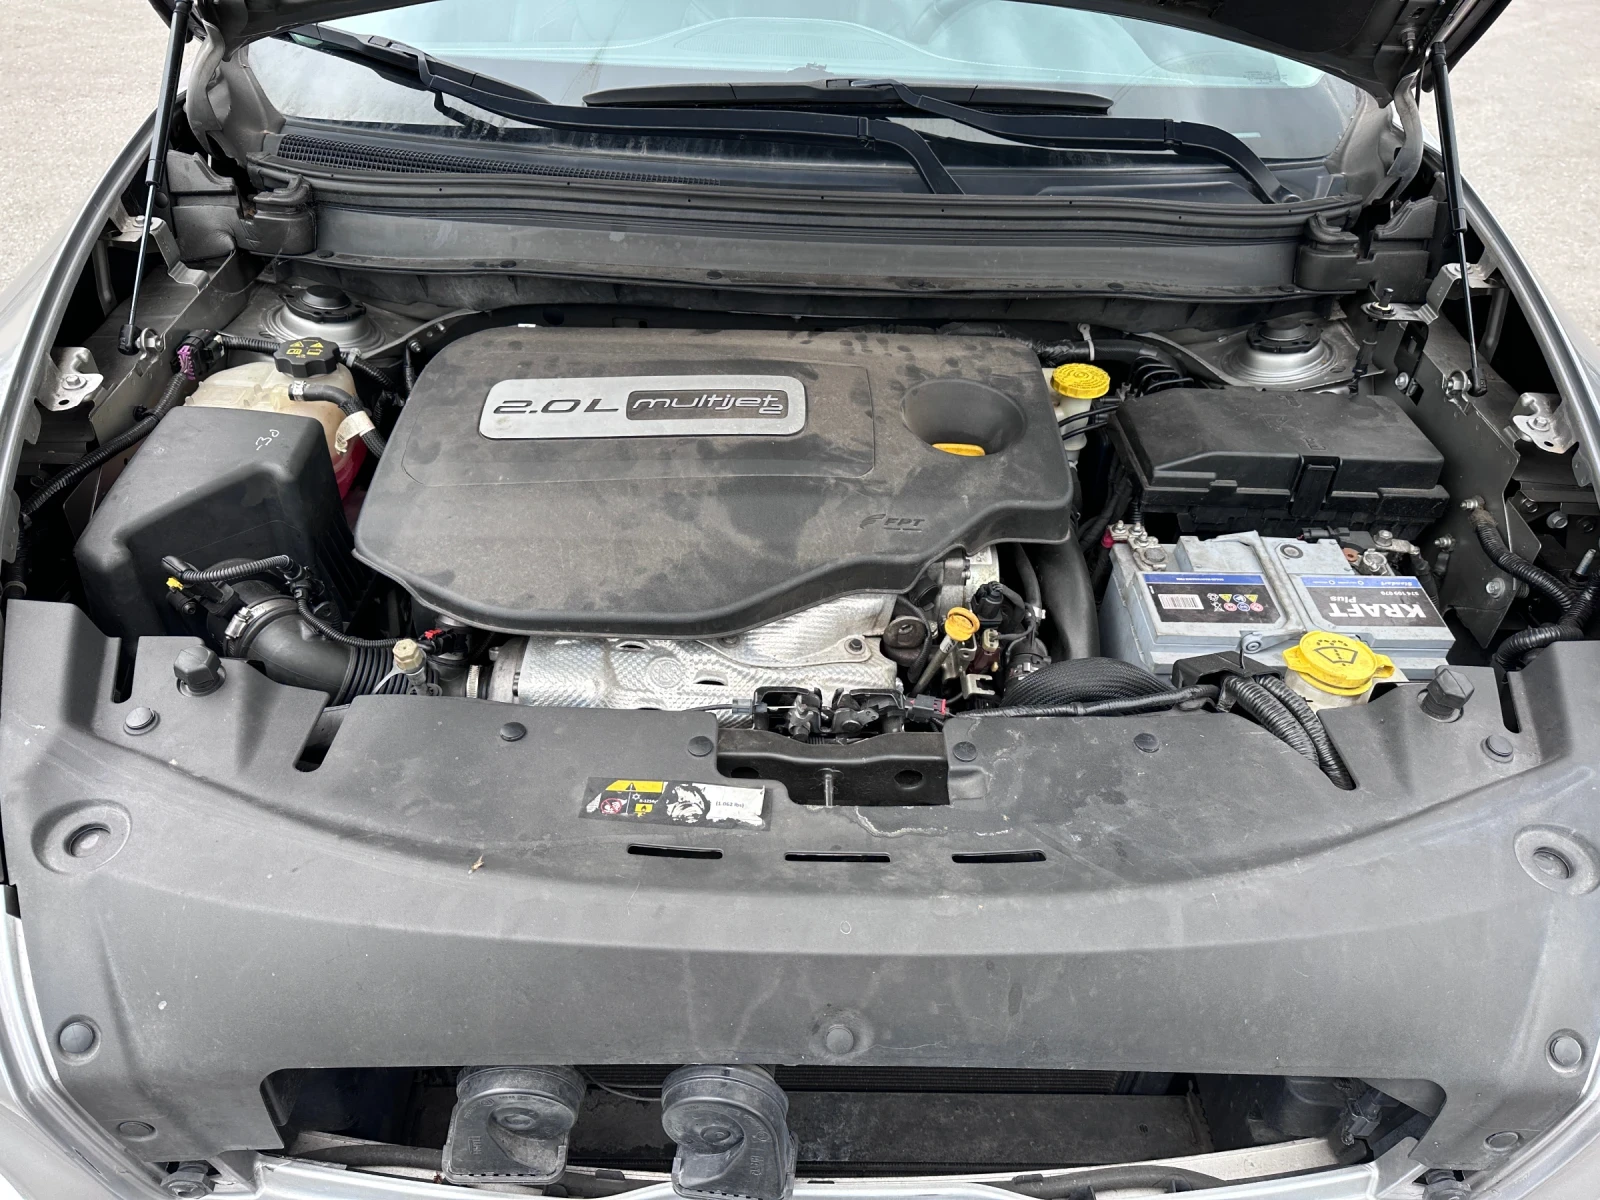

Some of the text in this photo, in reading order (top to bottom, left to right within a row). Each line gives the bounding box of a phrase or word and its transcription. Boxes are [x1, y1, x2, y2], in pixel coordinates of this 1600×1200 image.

[493, 398, 619, 414] 2.0L
[632, 394, 778, 410] multijet
[884, 517, 925, 527] FPT
[1329, 595, 1357, 604] Plus
[1328, 603, 1427, 618] KRAFT
